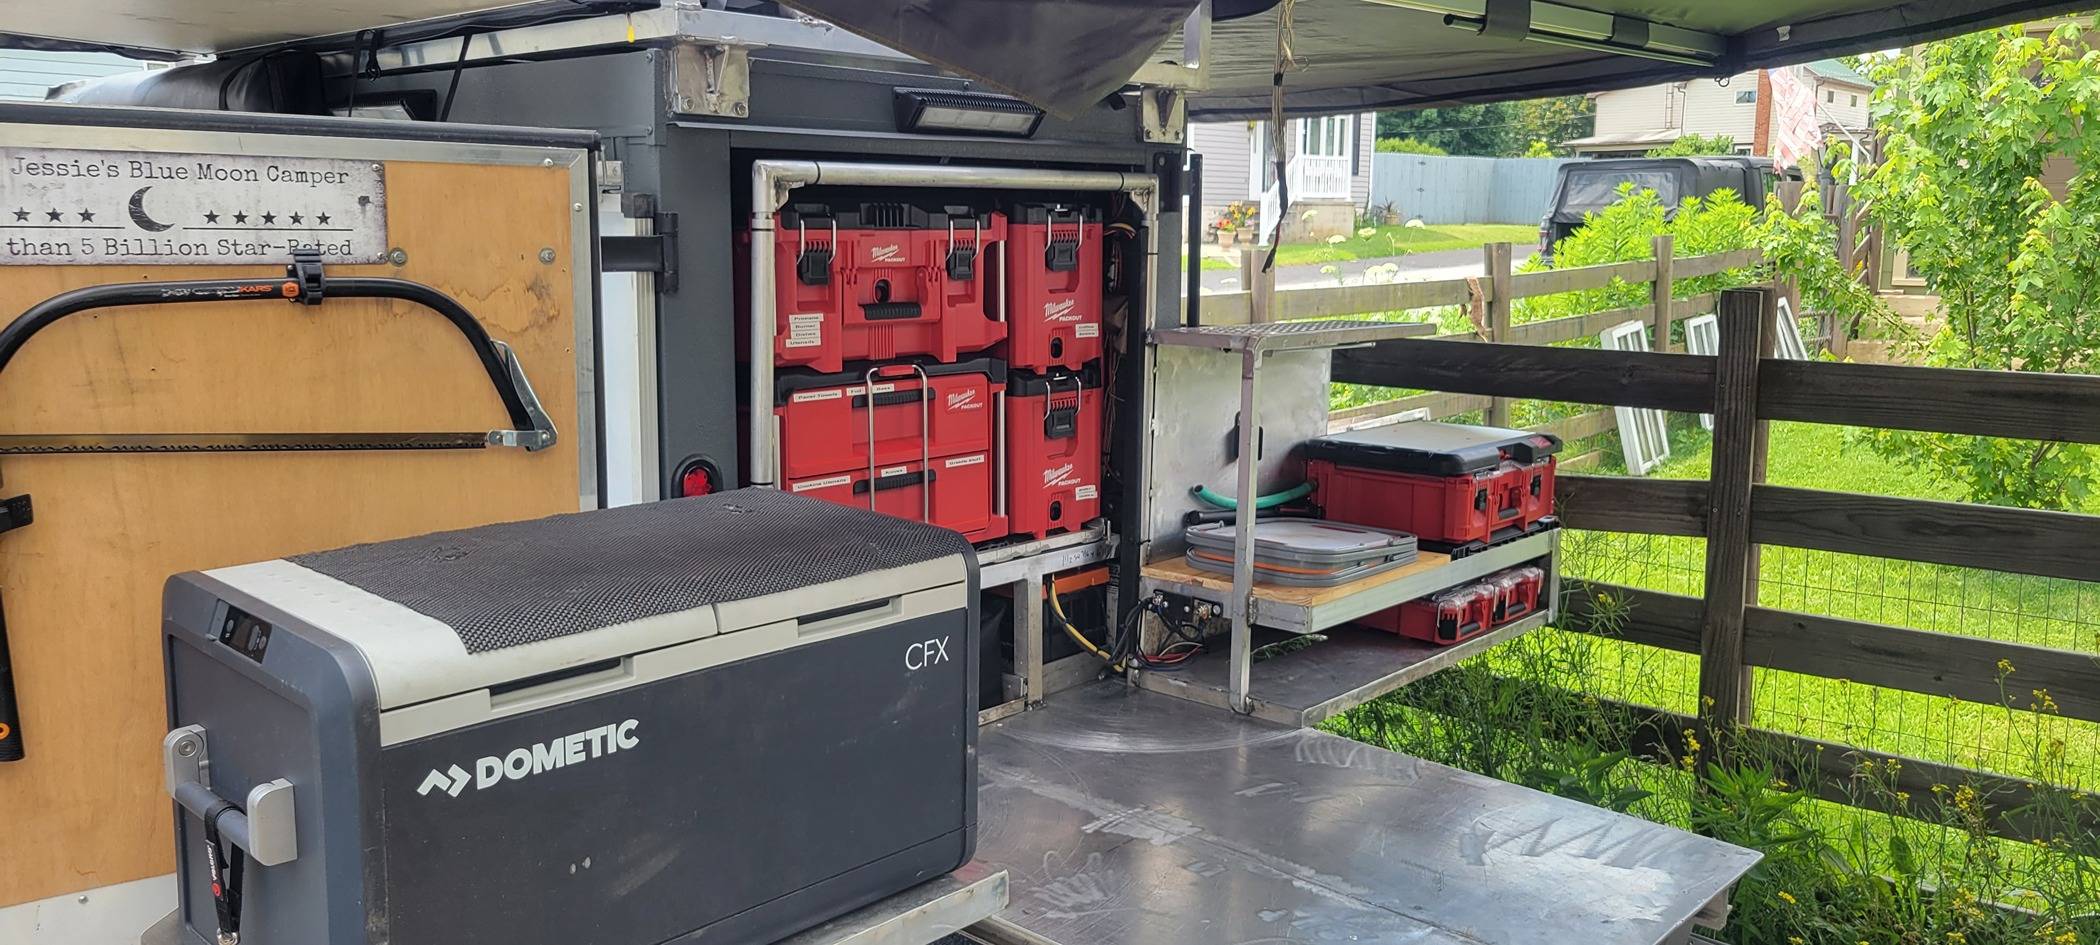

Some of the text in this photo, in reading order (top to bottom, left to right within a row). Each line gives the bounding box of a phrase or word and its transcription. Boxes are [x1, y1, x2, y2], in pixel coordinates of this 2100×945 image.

[11, 157, 349, 188] Jessie's Blue Moon Camper
[6, 238, 72, 256] than
[81, 238, 95, 255] 5
[104, 238, 208, 256] Billion
[1044, 298, 1074, 317] Milwaukee
[947, 389, 976, 406] Milwaukee
[1043, 463, 1073, 484] Milwaukee
[905, 635, 949, 670] CFX
[476, 718, 640, 790] DOMETIC
